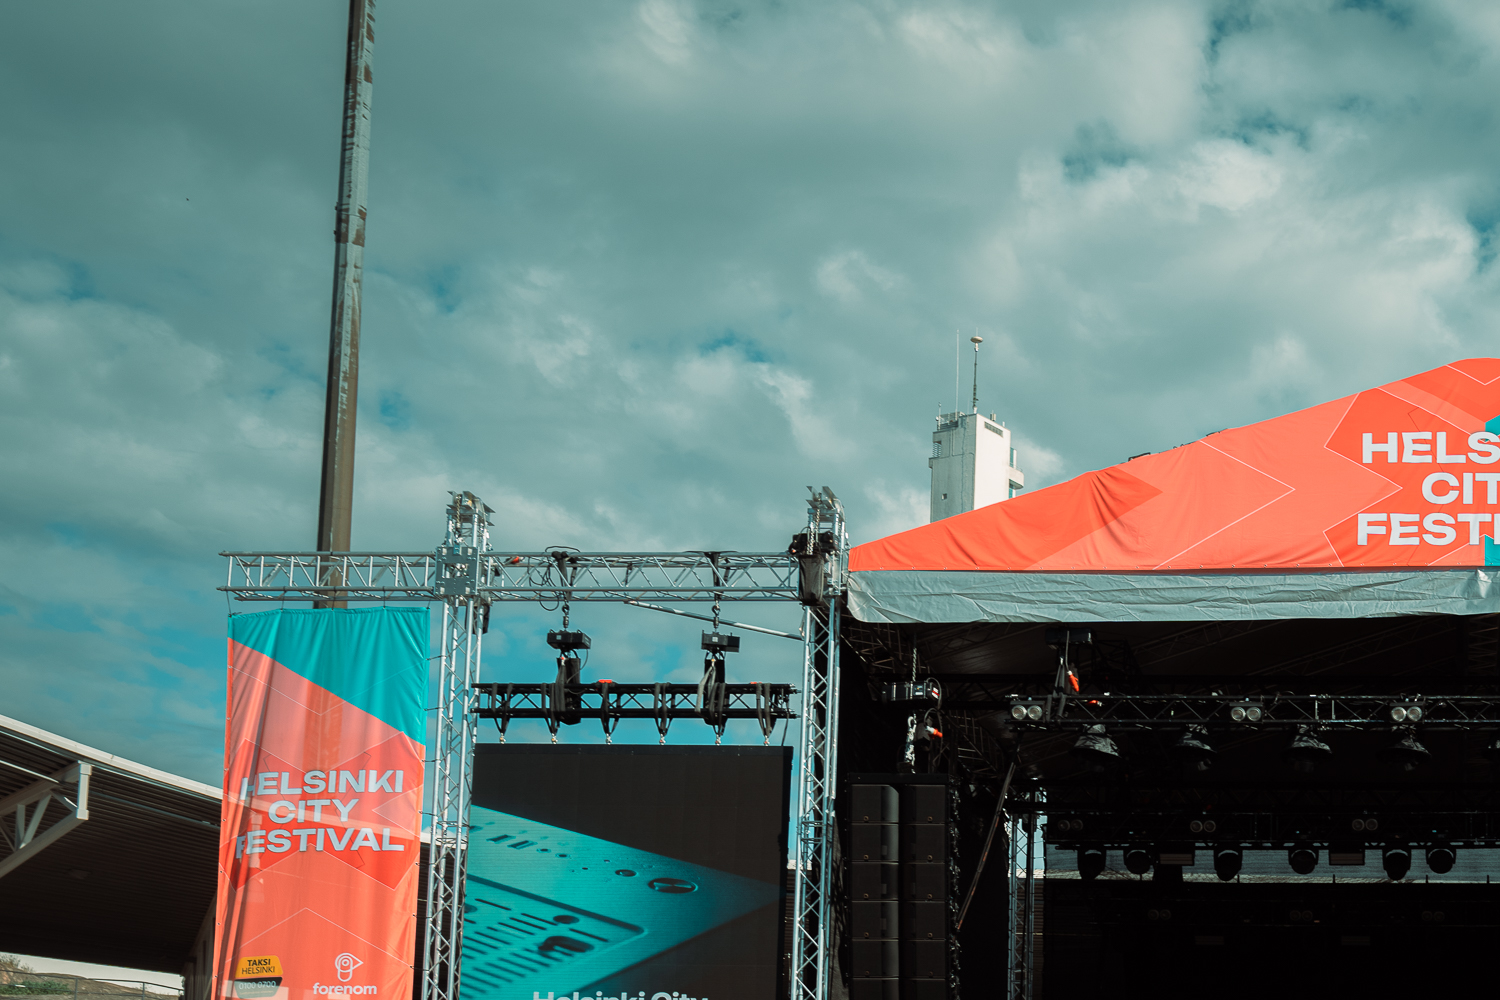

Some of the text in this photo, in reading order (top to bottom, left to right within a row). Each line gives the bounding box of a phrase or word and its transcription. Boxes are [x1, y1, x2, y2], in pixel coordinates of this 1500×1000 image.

[240, 769, 404, 800] HELSINKI
[268, 798, 359, 824] CITY
[235, 828, 405, 859] FESTIVAL
[247, 958, 271, 966] TAKSI
[241, 966, 275, 975] HELSINKI
[238, 980, 277, 990] 0100 0700
[313, 982, 377, 995] forenom
